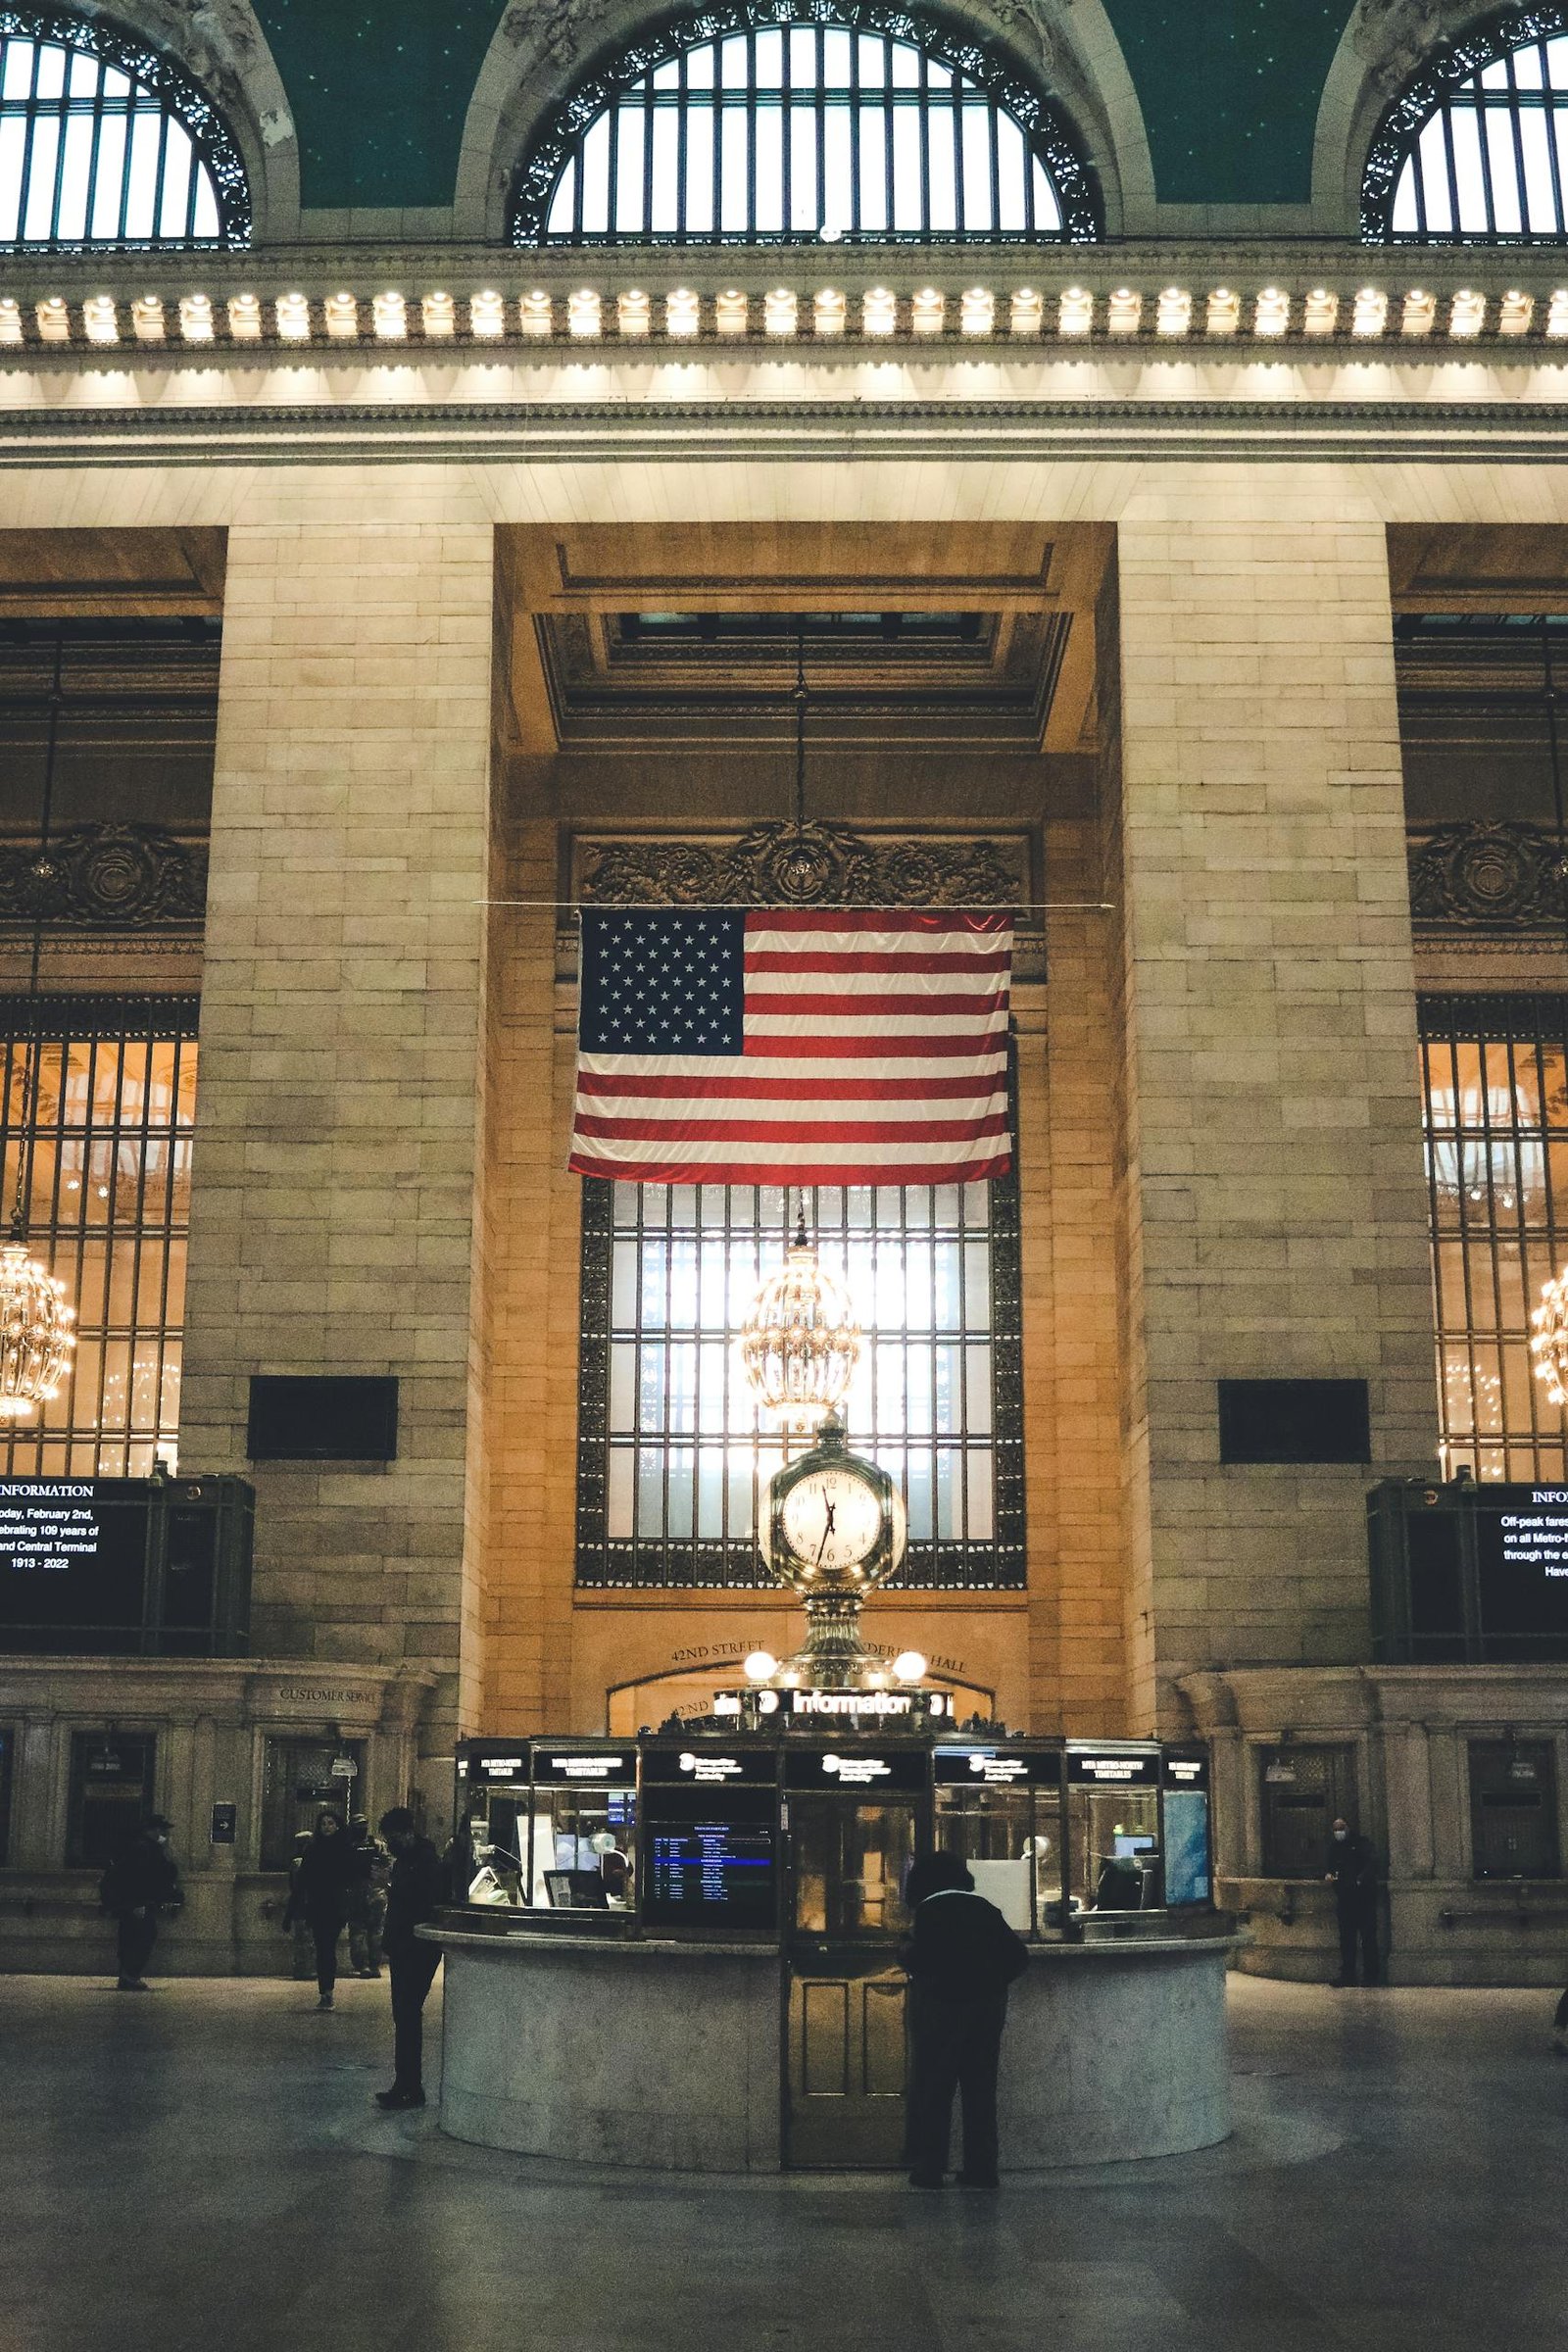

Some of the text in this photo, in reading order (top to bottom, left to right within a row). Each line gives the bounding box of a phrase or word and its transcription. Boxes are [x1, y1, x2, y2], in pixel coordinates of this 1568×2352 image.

[809, 1483, 817, 1494] 11
[826, 1477, 837, 1489] 12
[0, 1484, 95, 1497] NFORMATION
[1531, 1491, 1568, 1503] INFO
[26, 1508, 71, 1521] February
[72, 1509, 93, 1521] 2nd,
[1500, 1515, 1544, 1529] Off-peak
[40, 1525, 58, 1536] 109
[59, 1527, 87, 1538] years
[88, 1526, 99, 1536] of
[797, 1532, 804, 1544] 8
[1503, 1534, 1517, 1544] on
[1519, 1533, 1531, 1544] all
[17, 1541, 53, 1551] Central
[55, 1542, 97, 1552] Terminal
[809, 1544, 816, 1556] 7
[844, 1544, 853, 1558] 5
[827, 1548, 835, 1561] 6
[1503, 1549, 1543, 1562] through
[1544, 1549, 1560, 1560] the
[11, 1557, 35, 1568] 1913
[43, 1558, 70, 1568] 2022
[671, 1640, 764, 1661] 42ND STREET
[930, 1655, 965, 1673] HALL
[280, 1689, 345, 1702] CUSTOMER
[674, 1700, 709, 1716] 2ND
[793, 1690, 911, 1715] Information
